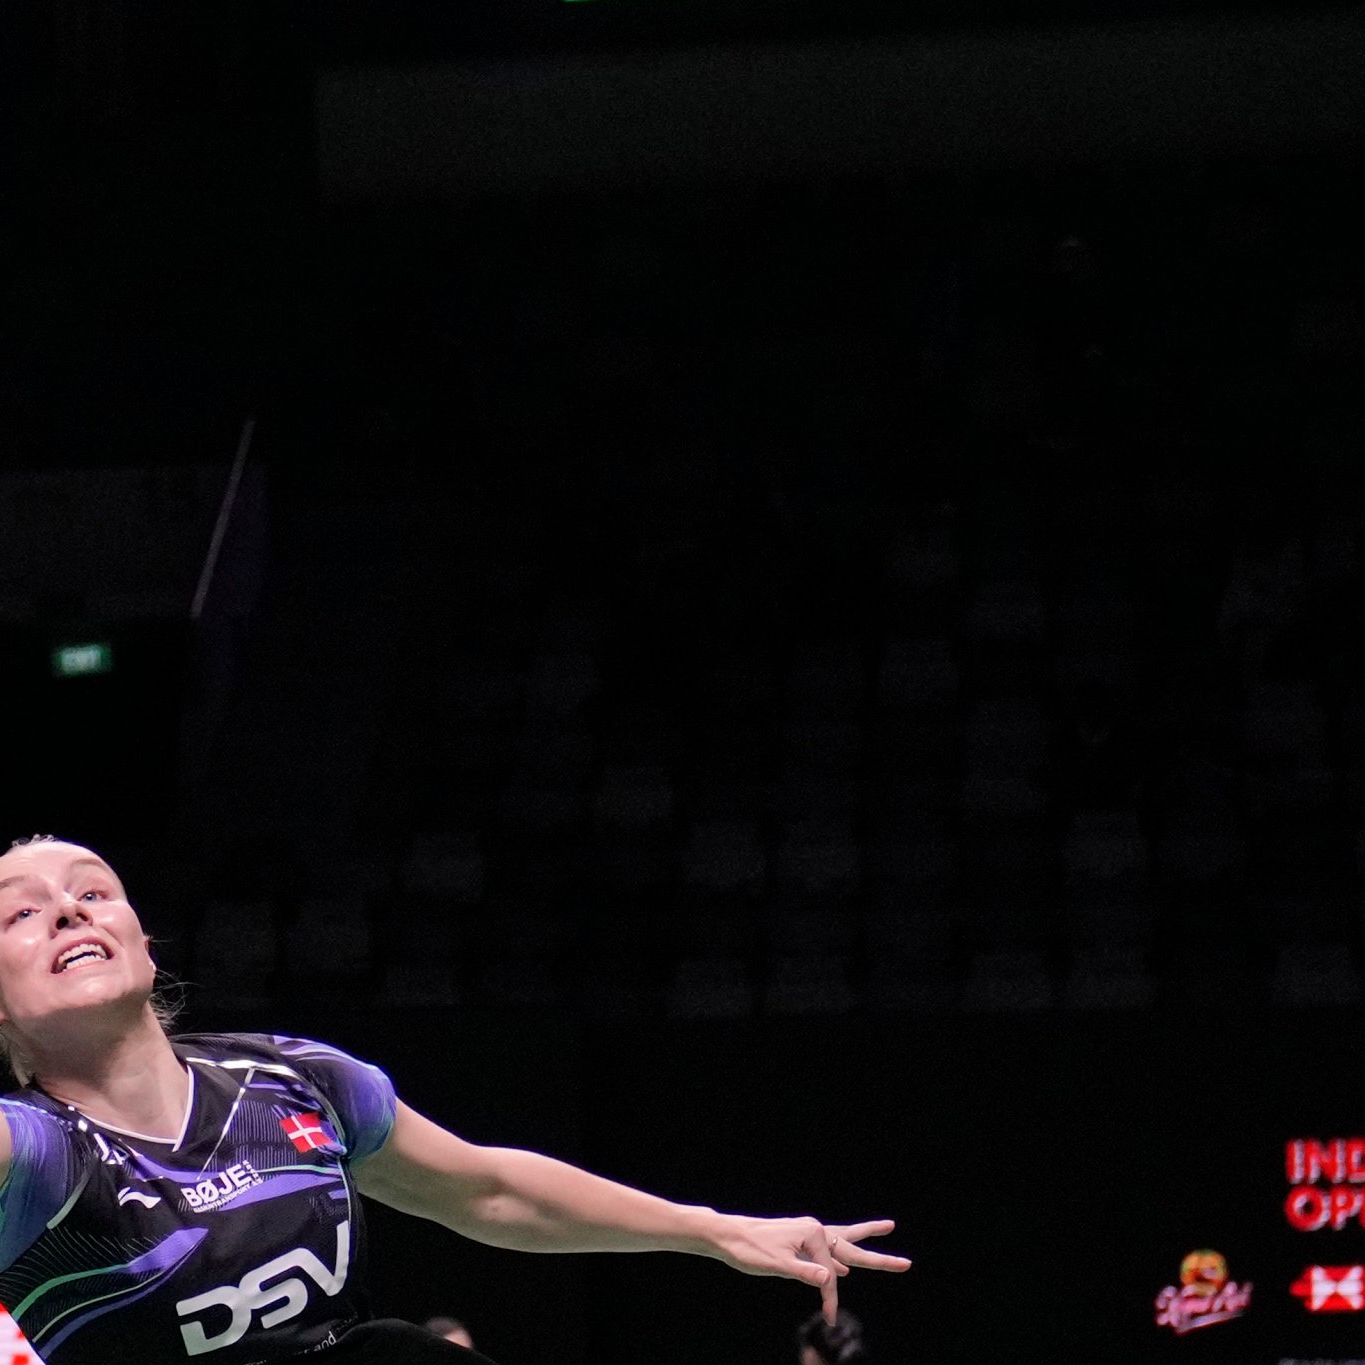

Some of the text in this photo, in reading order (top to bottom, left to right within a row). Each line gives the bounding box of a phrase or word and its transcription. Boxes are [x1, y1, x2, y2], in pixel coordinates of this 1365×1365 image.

[181, 1163, 252, 1207] BØJE
[1284, 1184, 1365, 1232] OP
[175, 1220, 351, 1356] DSV
